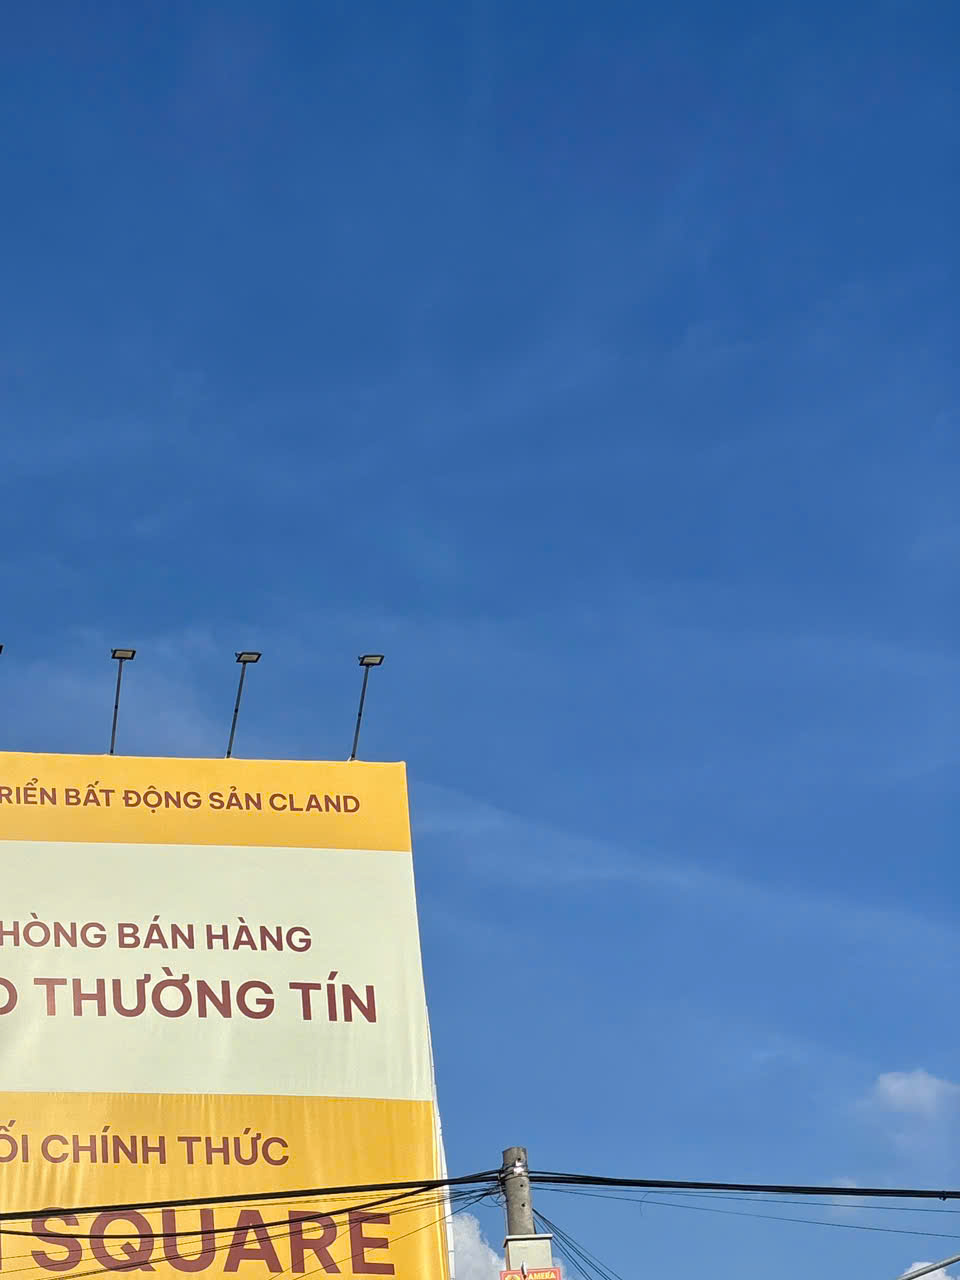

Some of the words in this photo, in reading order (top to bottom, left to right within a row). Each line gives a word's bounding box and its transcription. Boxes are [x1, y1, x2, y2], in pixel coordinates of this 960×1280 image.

[65, 780, 115, 807] BẤT
[122, 785, 202, 814] ĐỘNG
[209, 786, 262, 811] SẢN
[269, 793, 361, 814] CLAND
[118, 915, 195, 950] BÁN
[207, 917, 312, 953] HÀNG
[33, 966, 276, 1019] THƯỜNG
[289, 970, 378, 1023] TÍN
[40, 1125, 166, 1165] CHÍNH
[177, 1127, 290, 1166] THỨC
[31, 1206, 395, 1276] SQUARE
[524, 1272, 555, 1280] AMERA
